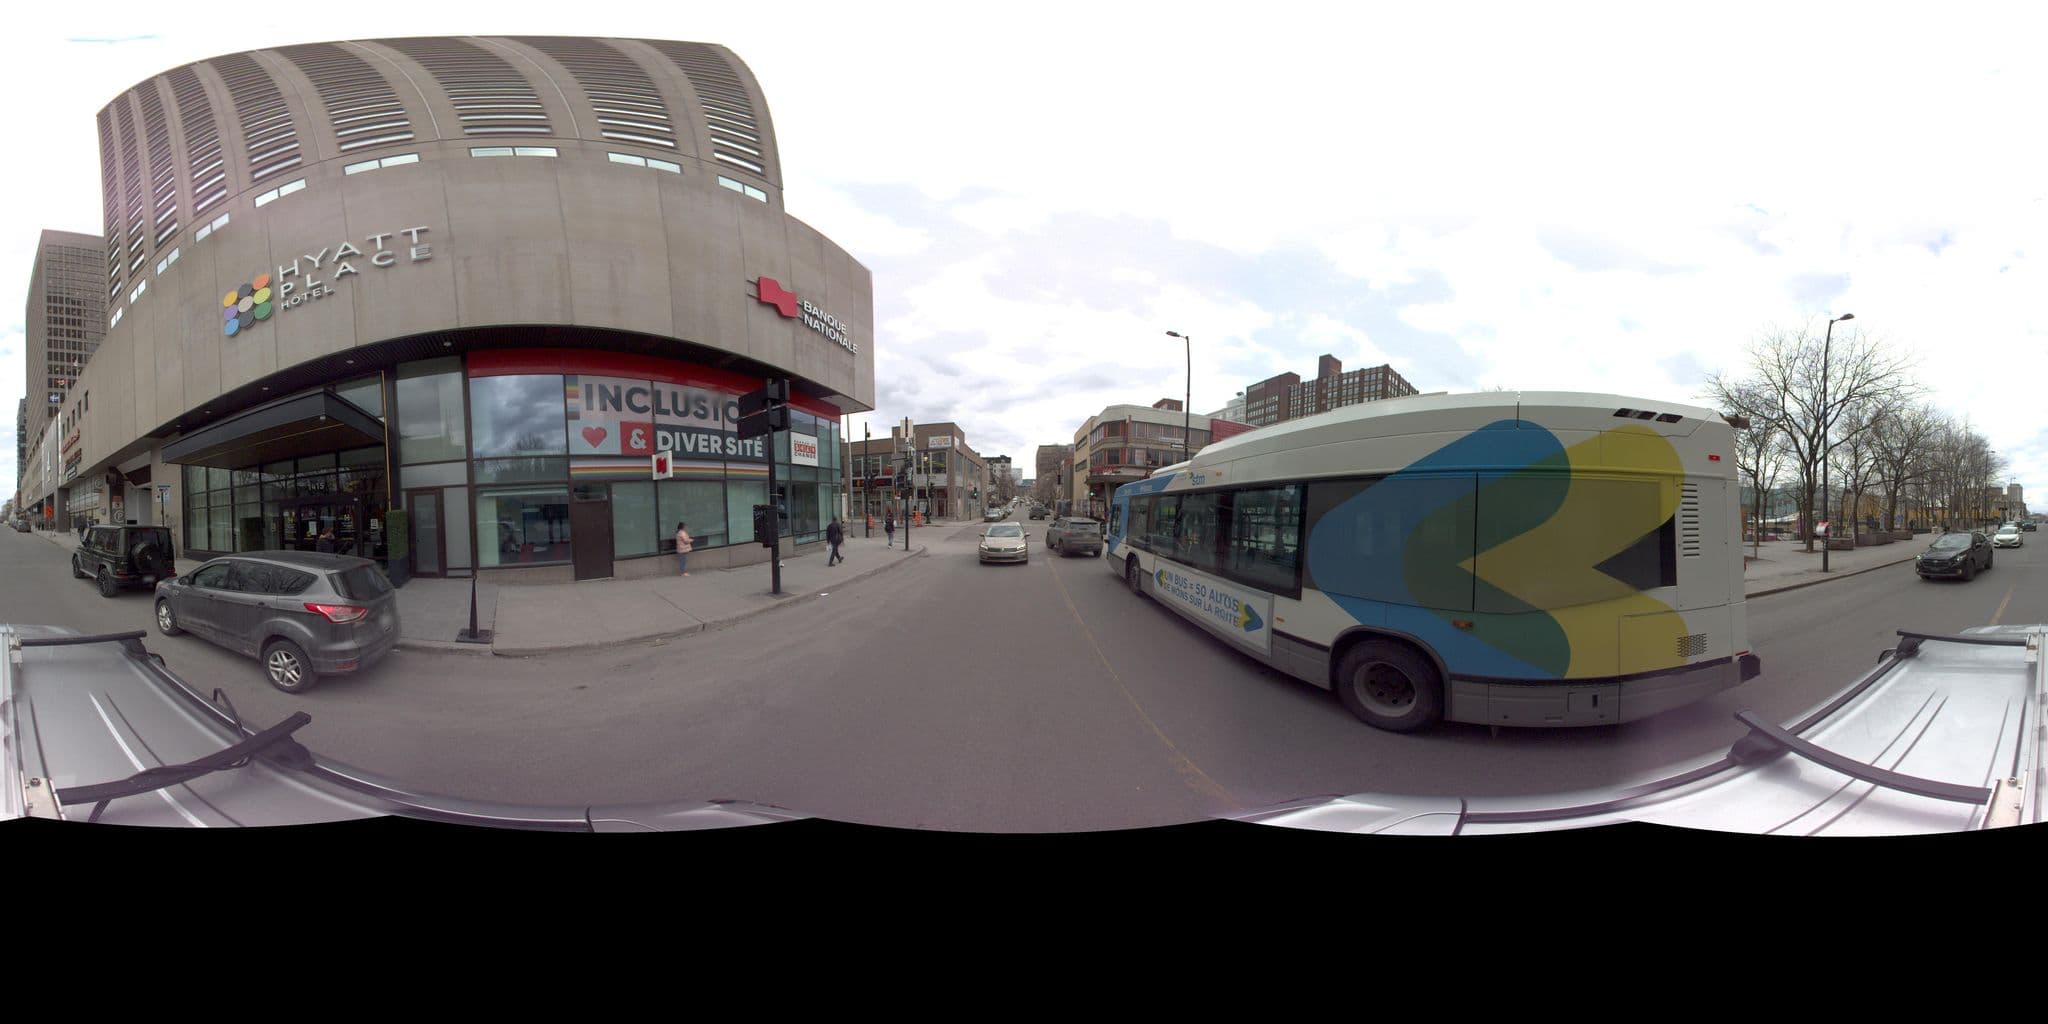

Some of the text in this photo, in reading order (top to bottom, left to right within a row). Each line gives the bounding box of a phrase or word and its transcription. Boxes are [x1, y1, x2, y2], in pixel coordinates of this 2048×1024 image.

[279, 226, 429, 282] HYATT
[280, 243, 432, 298] PLACE
[281, 285, 334, 310] HÔTEL
[803, 300, 847, 335] BANQUE
[804, 313, 858, 354] NATIONALE
[585, 383, 739, 424] INCLUSIO
[629, 428, 764, 457] & DIVERSITÉ
[1174, 574, 1188, 589] BUS
[1195, 583, 1207, 597] 50
[1209, 589, 1239, 612] AUTOS
[1204, 602, 1213, 613] LA
